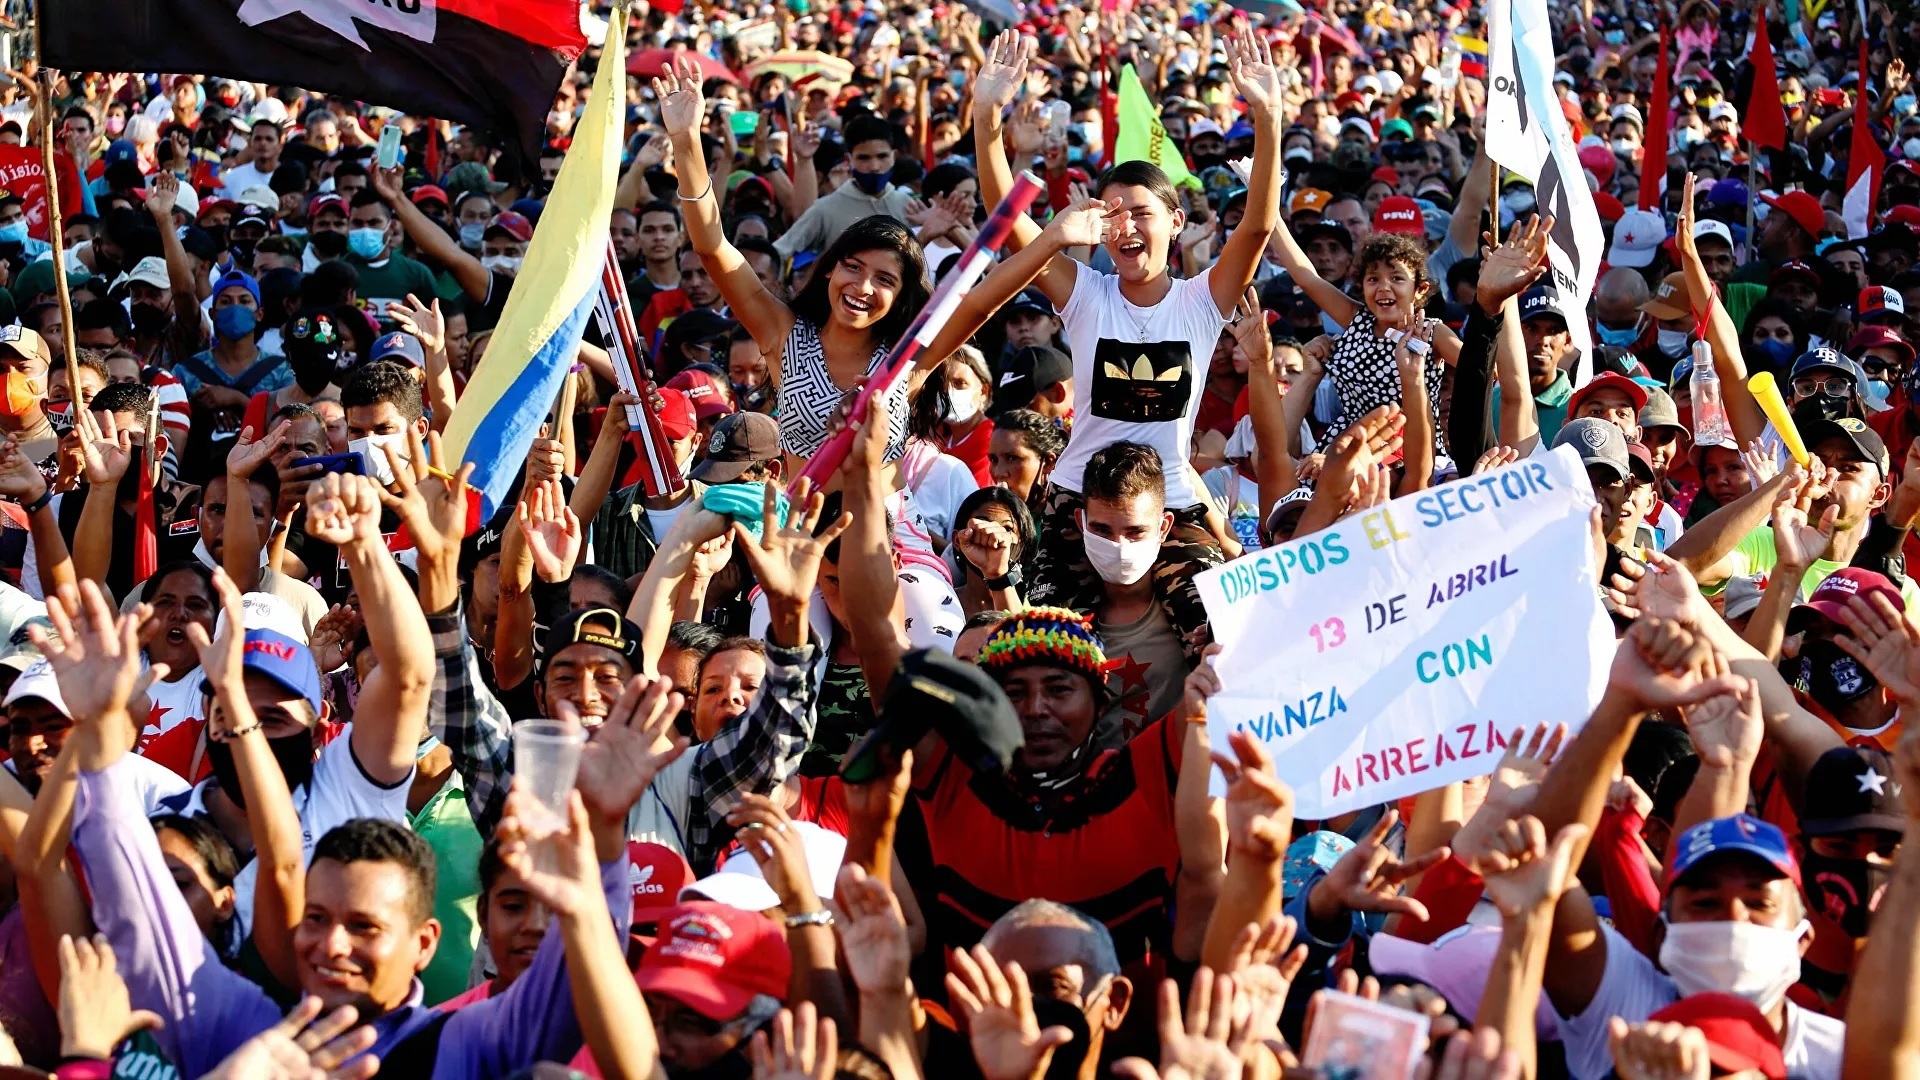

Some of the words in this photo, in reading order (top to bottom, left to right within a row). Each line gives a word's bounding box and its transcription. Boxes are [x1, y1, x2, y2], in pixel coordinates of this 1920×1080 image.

[477, 529, 503, 551] FIL
[1220, 532, 1350, 605] OBISPOS
[1361, 508, 1410, 551] EL
[1415, 462, 1555, 528] SECTOR
[1308, 617, 1347, 653] 13
[1365, 593, 1408, 634] DE
[1426, 554, 1519, 610] ABRIL
[1416, 634, 1493, 684] CON
[1237, 686, 1348, 743] VANZA
[1332, 720, 1508, 797] ARREAZA
